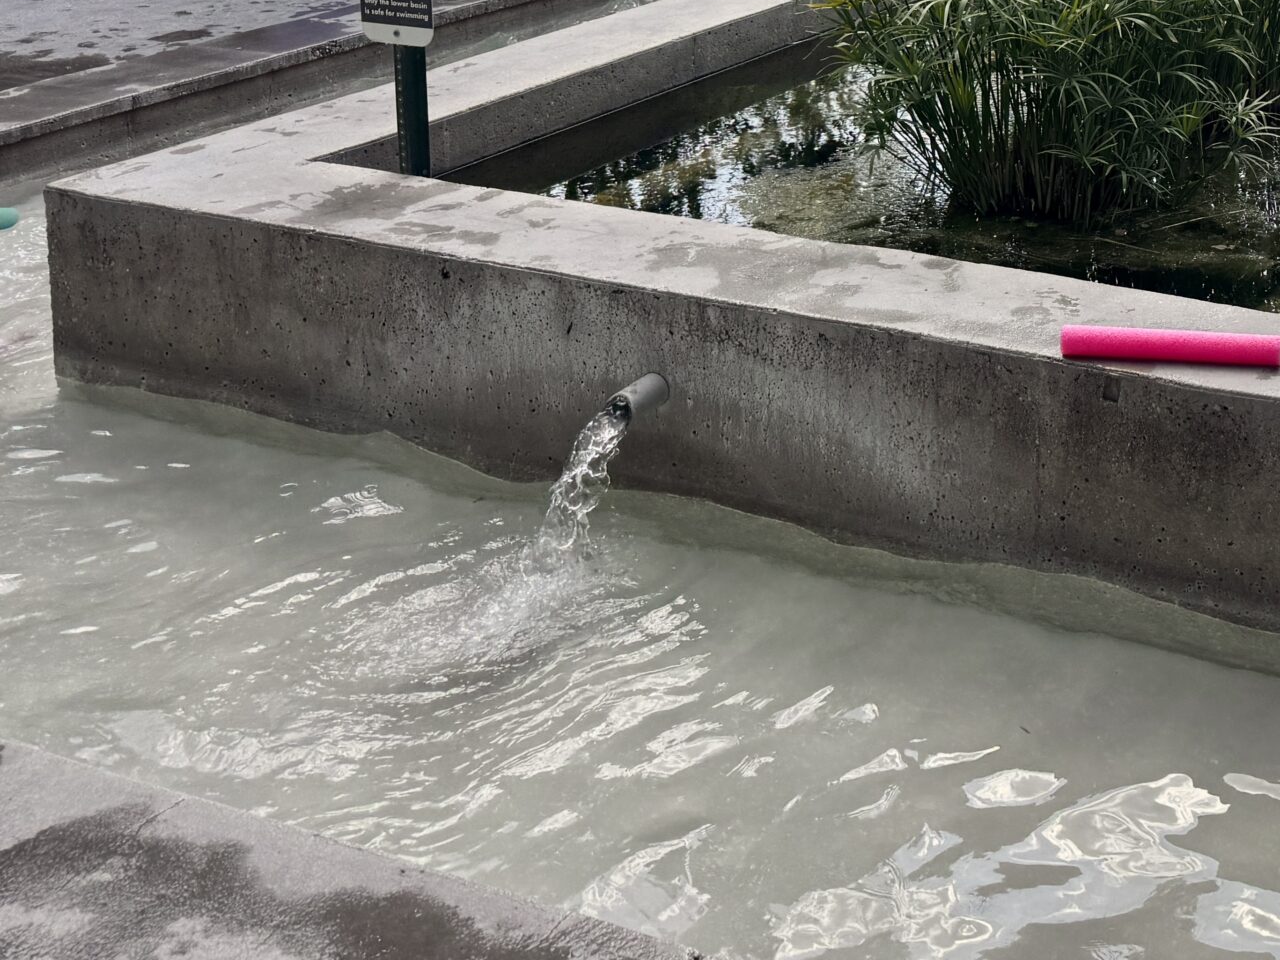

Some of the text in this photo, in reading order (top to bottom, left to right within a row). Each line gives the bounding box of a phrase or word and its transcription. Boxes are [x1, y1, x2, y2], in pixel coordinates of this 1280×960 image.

[390, 0, 409, 8] lower
[410, 0, 428, 10] basin
[371, 8, 385, 16] safe
[385, 9, 395, 17] for
[396, 11, 429, 22] swimming
